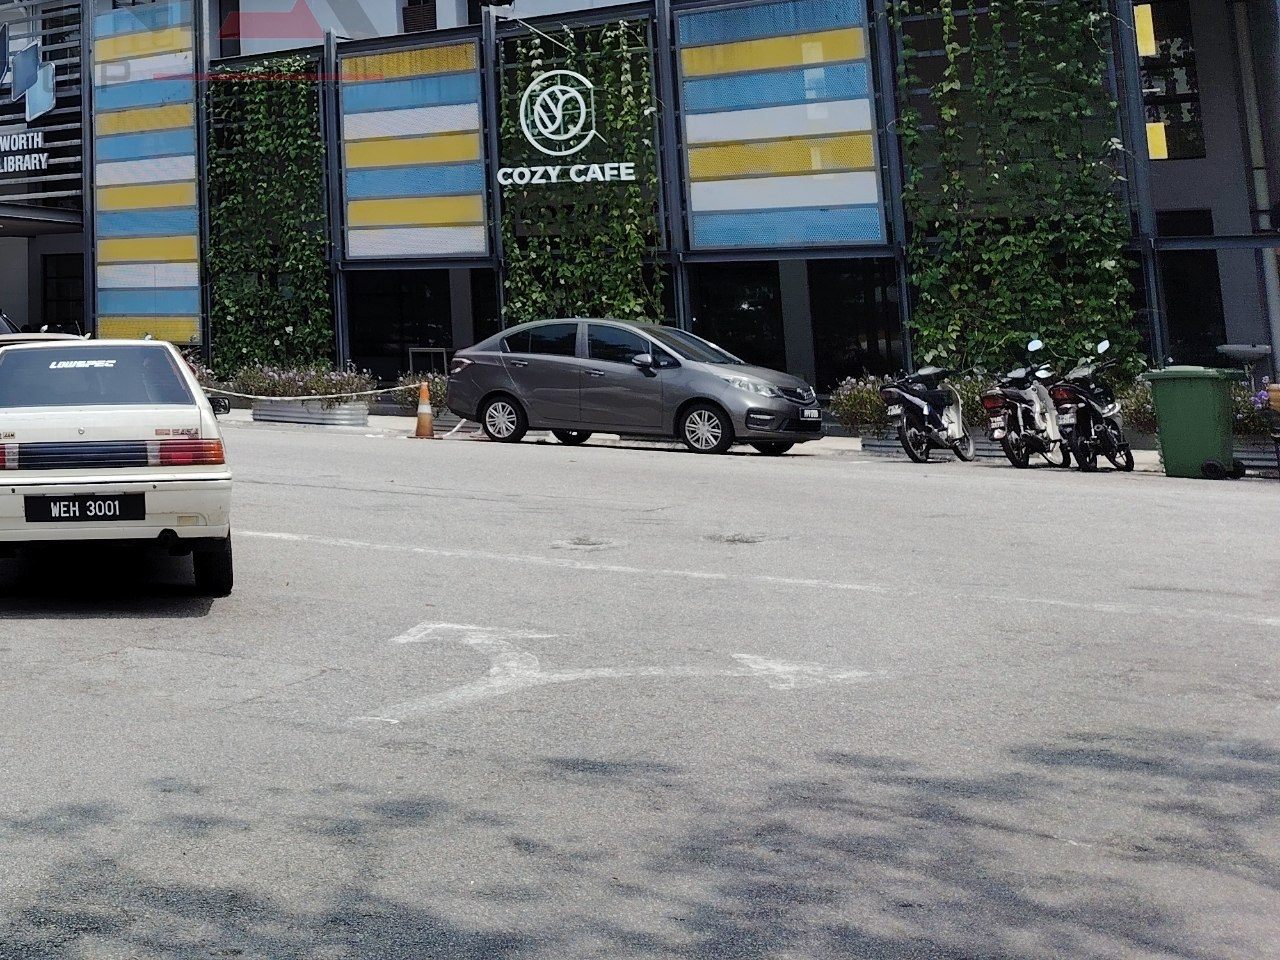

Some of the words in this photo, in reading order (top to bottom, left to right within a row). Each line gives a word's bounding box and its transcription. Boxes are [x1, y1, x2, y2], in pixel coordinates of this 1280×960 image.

[496, 165, 561, 186] COZY
[570, 162, 636, 183] CAFE
[48, 359, 117, 369] LOWSPEC
[50, 501, 80, 518] WEH
[86, 500, 121, 517] 3001
